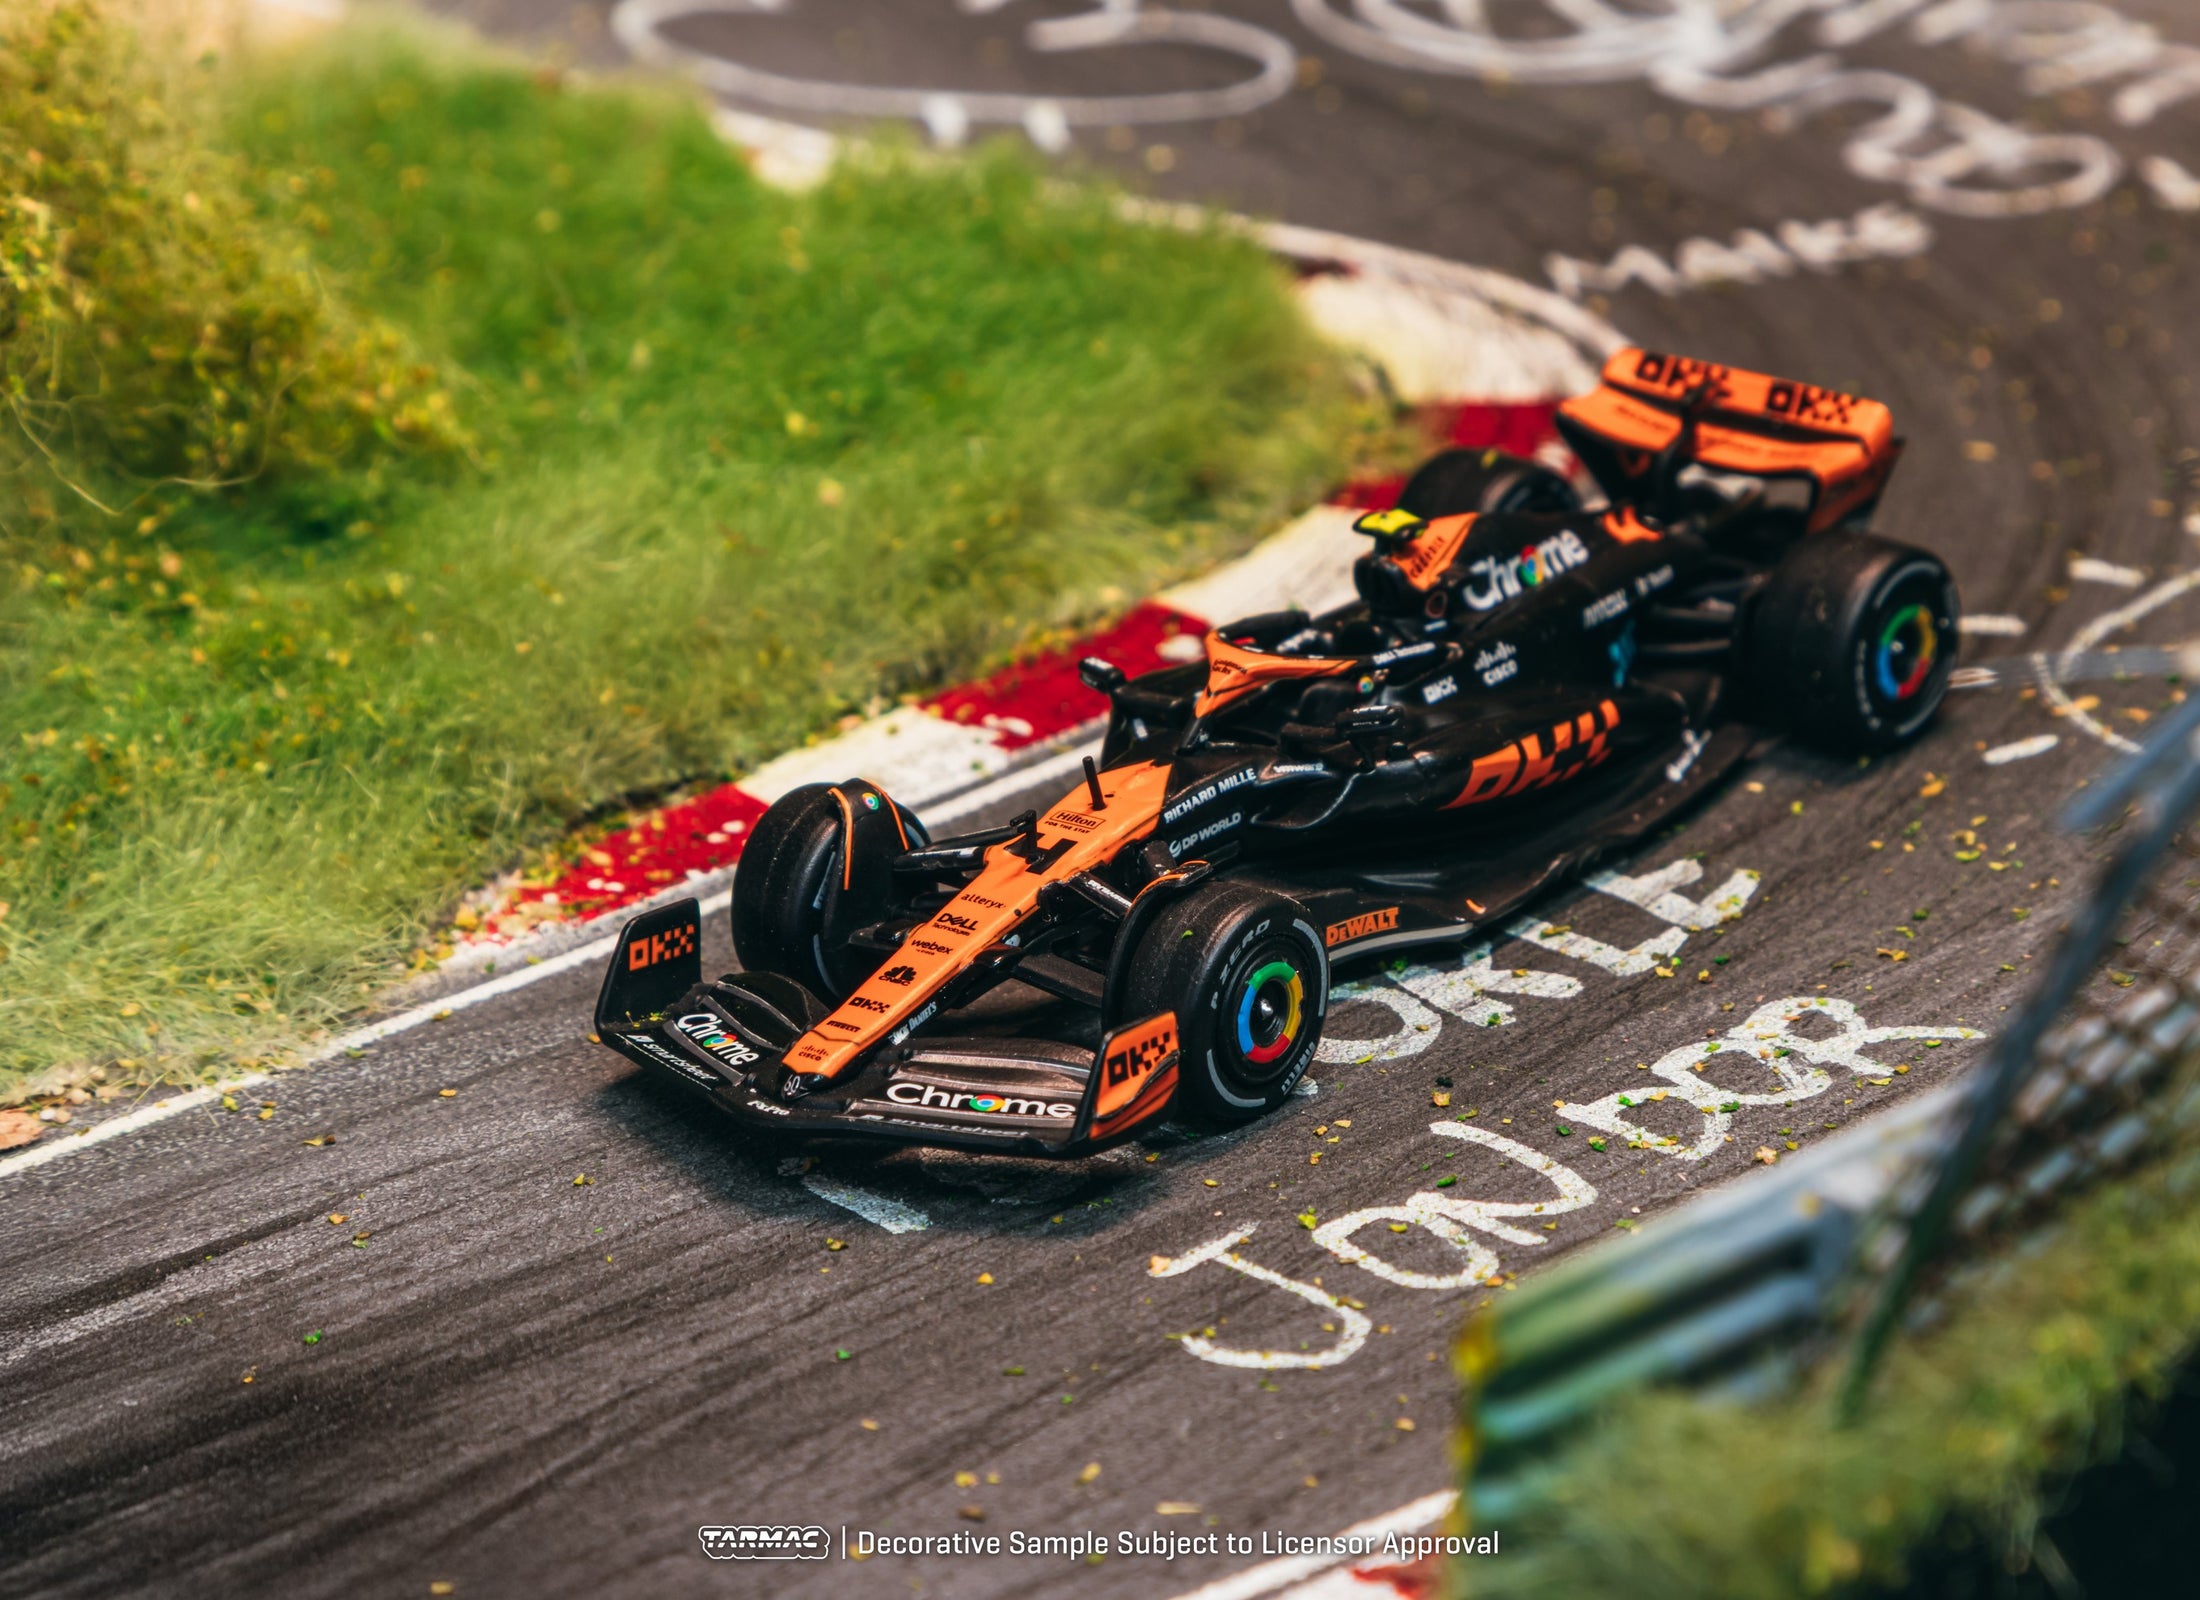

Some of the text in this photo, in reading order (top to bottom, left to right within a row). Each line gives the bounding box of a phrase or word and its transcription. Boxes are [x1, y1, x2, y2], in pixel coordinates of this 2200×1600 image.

[1463, 529, 1589, 611] Chrome
[1436, 699, 1621, 810] OKX
[1163, 768, 1257, 824] RICHARD MILLE
[1056, 811, 1097, 828] Hilton
[1182, 812, 1242, 851] DP WORLD
[961, 893, 1004, 909] alteryx
[936, 912, 979, 931] DELL
[629, 924, 695, 971] OKX
[911, 939, 954, 955] webex
[1220, 919, 1271, 985] ZERO
[878, 975, 911, 987] CNBC
[848, 997, 891, 1014] OKX
[676, 1013, 759, 1066] Chrome
[886, 1083, 1076, 1118] Chrome
